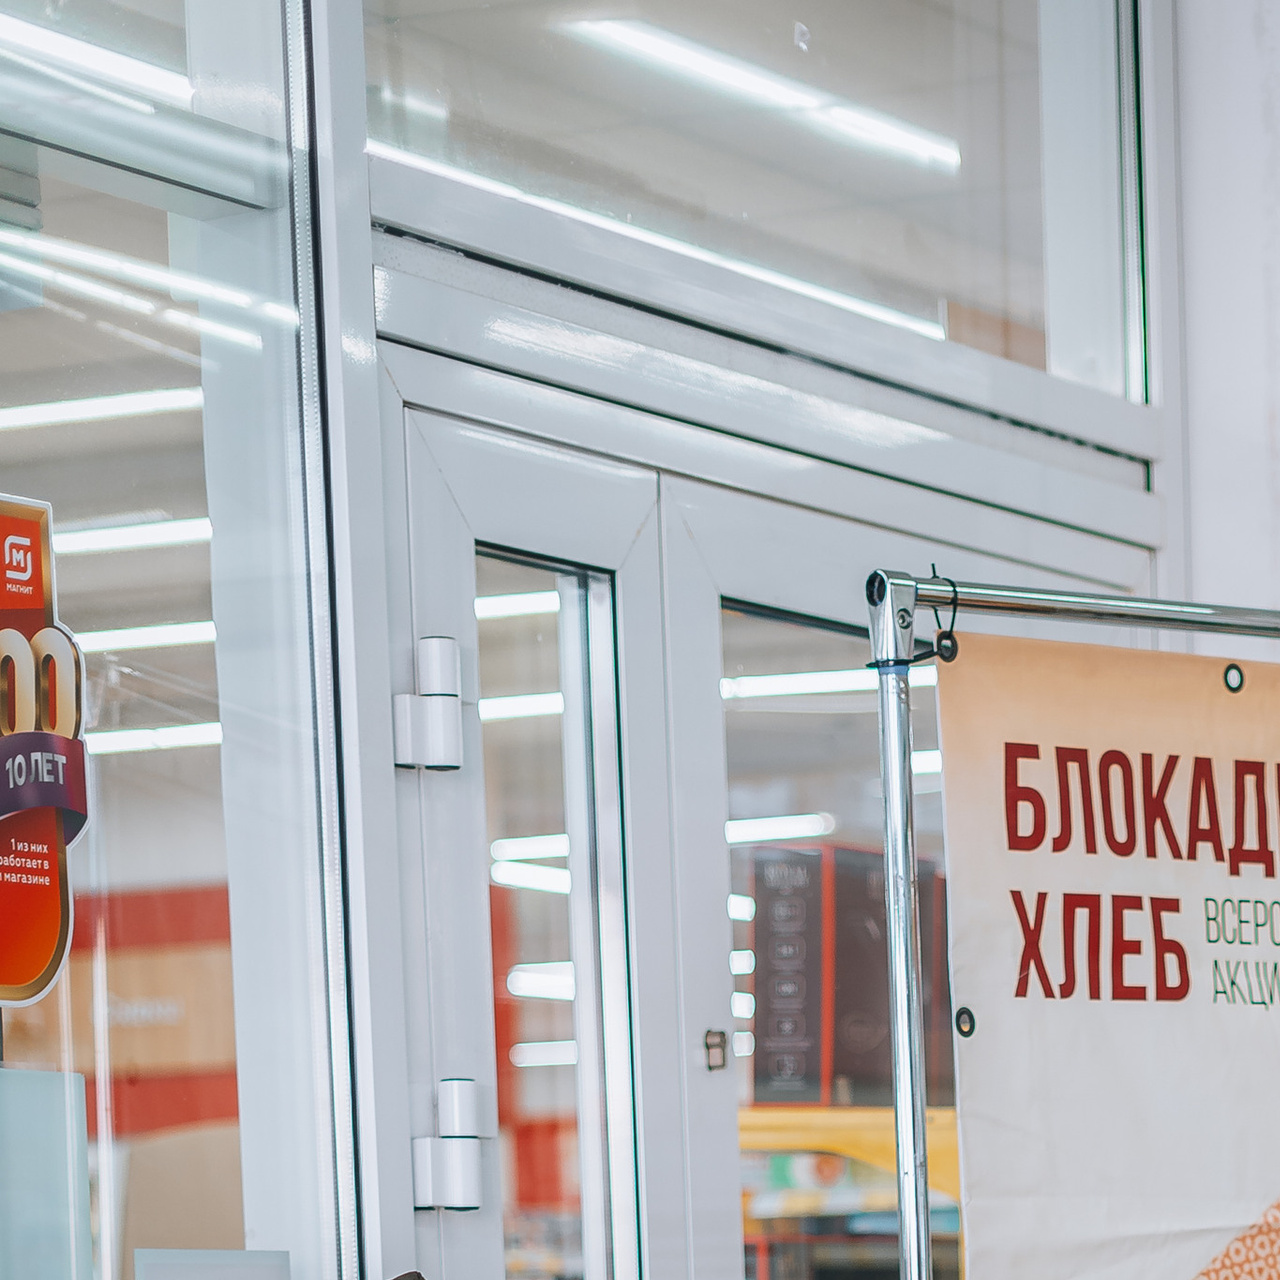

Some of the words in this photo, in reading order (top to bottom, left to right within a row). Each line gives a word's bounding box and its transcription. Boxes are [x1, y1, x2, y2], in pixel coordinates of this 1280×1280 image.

[6, 583, 33, 595] МАГНИТ
[5, 754, 27, 789] 10
[30, 751, 67, 785] ЛЕТ
[11, 838, 16, 851] 1
[17, 842, 29, 852] из
[30, 843, 49, 854] них
[43, 860, 49, 870] в
[4, 872, 50, 886] магазине
[1009, 890, 1190, 1002] ХЛЕБ
